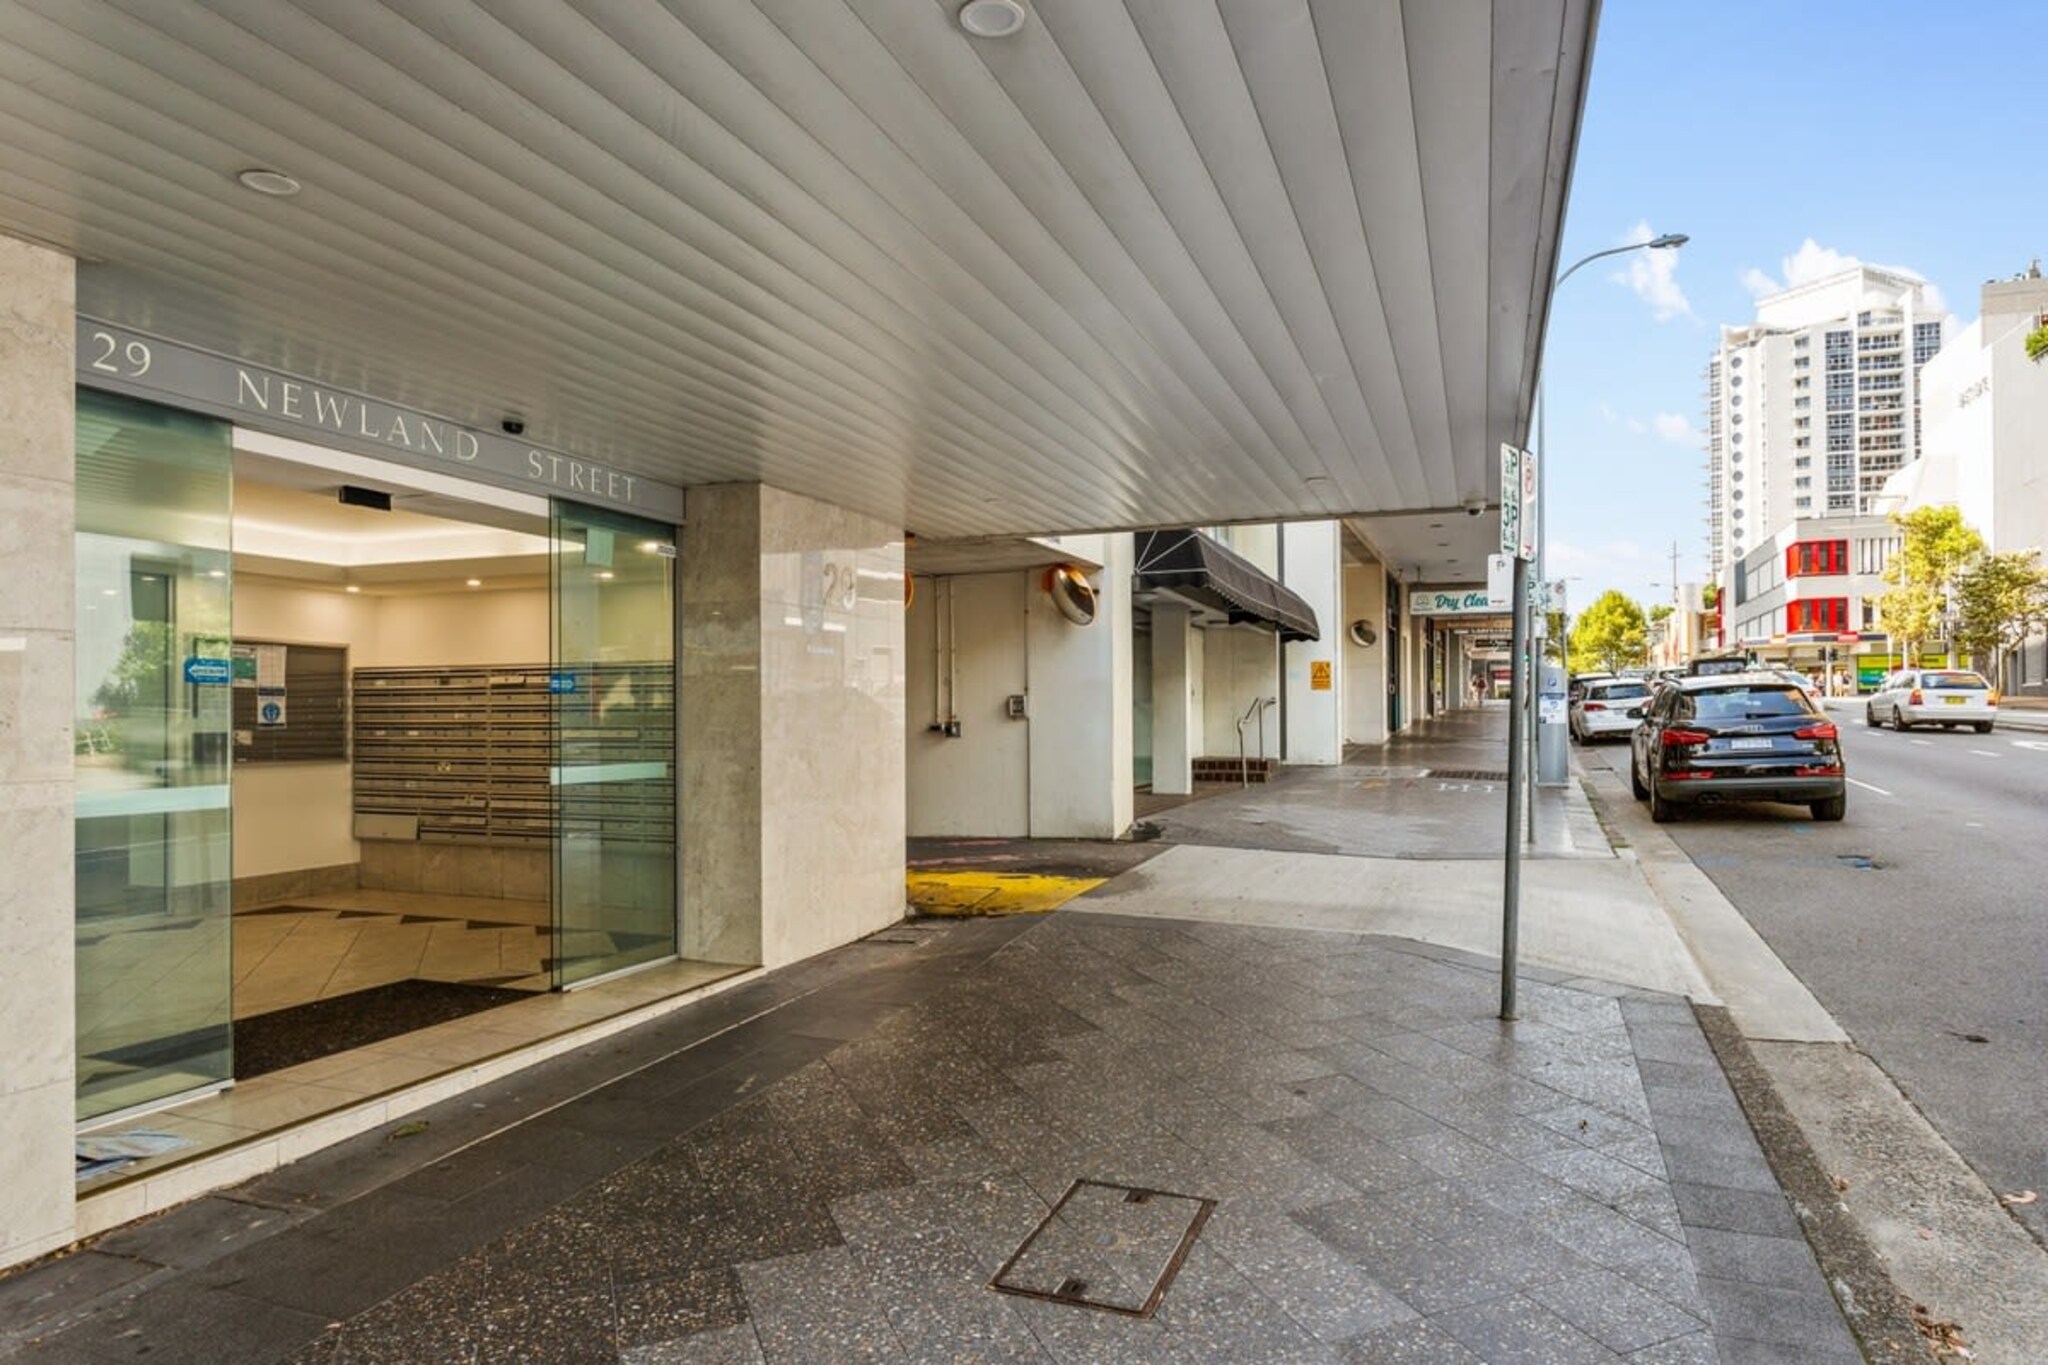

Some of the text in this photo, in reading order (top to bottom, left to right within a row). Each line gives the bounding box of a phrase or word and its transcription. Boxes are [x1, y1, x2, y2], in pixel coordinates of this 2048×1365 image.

[92, 333, 637, 502] 29 NEWLAND STREET
[1435, 594, 1459, 611] Dry
